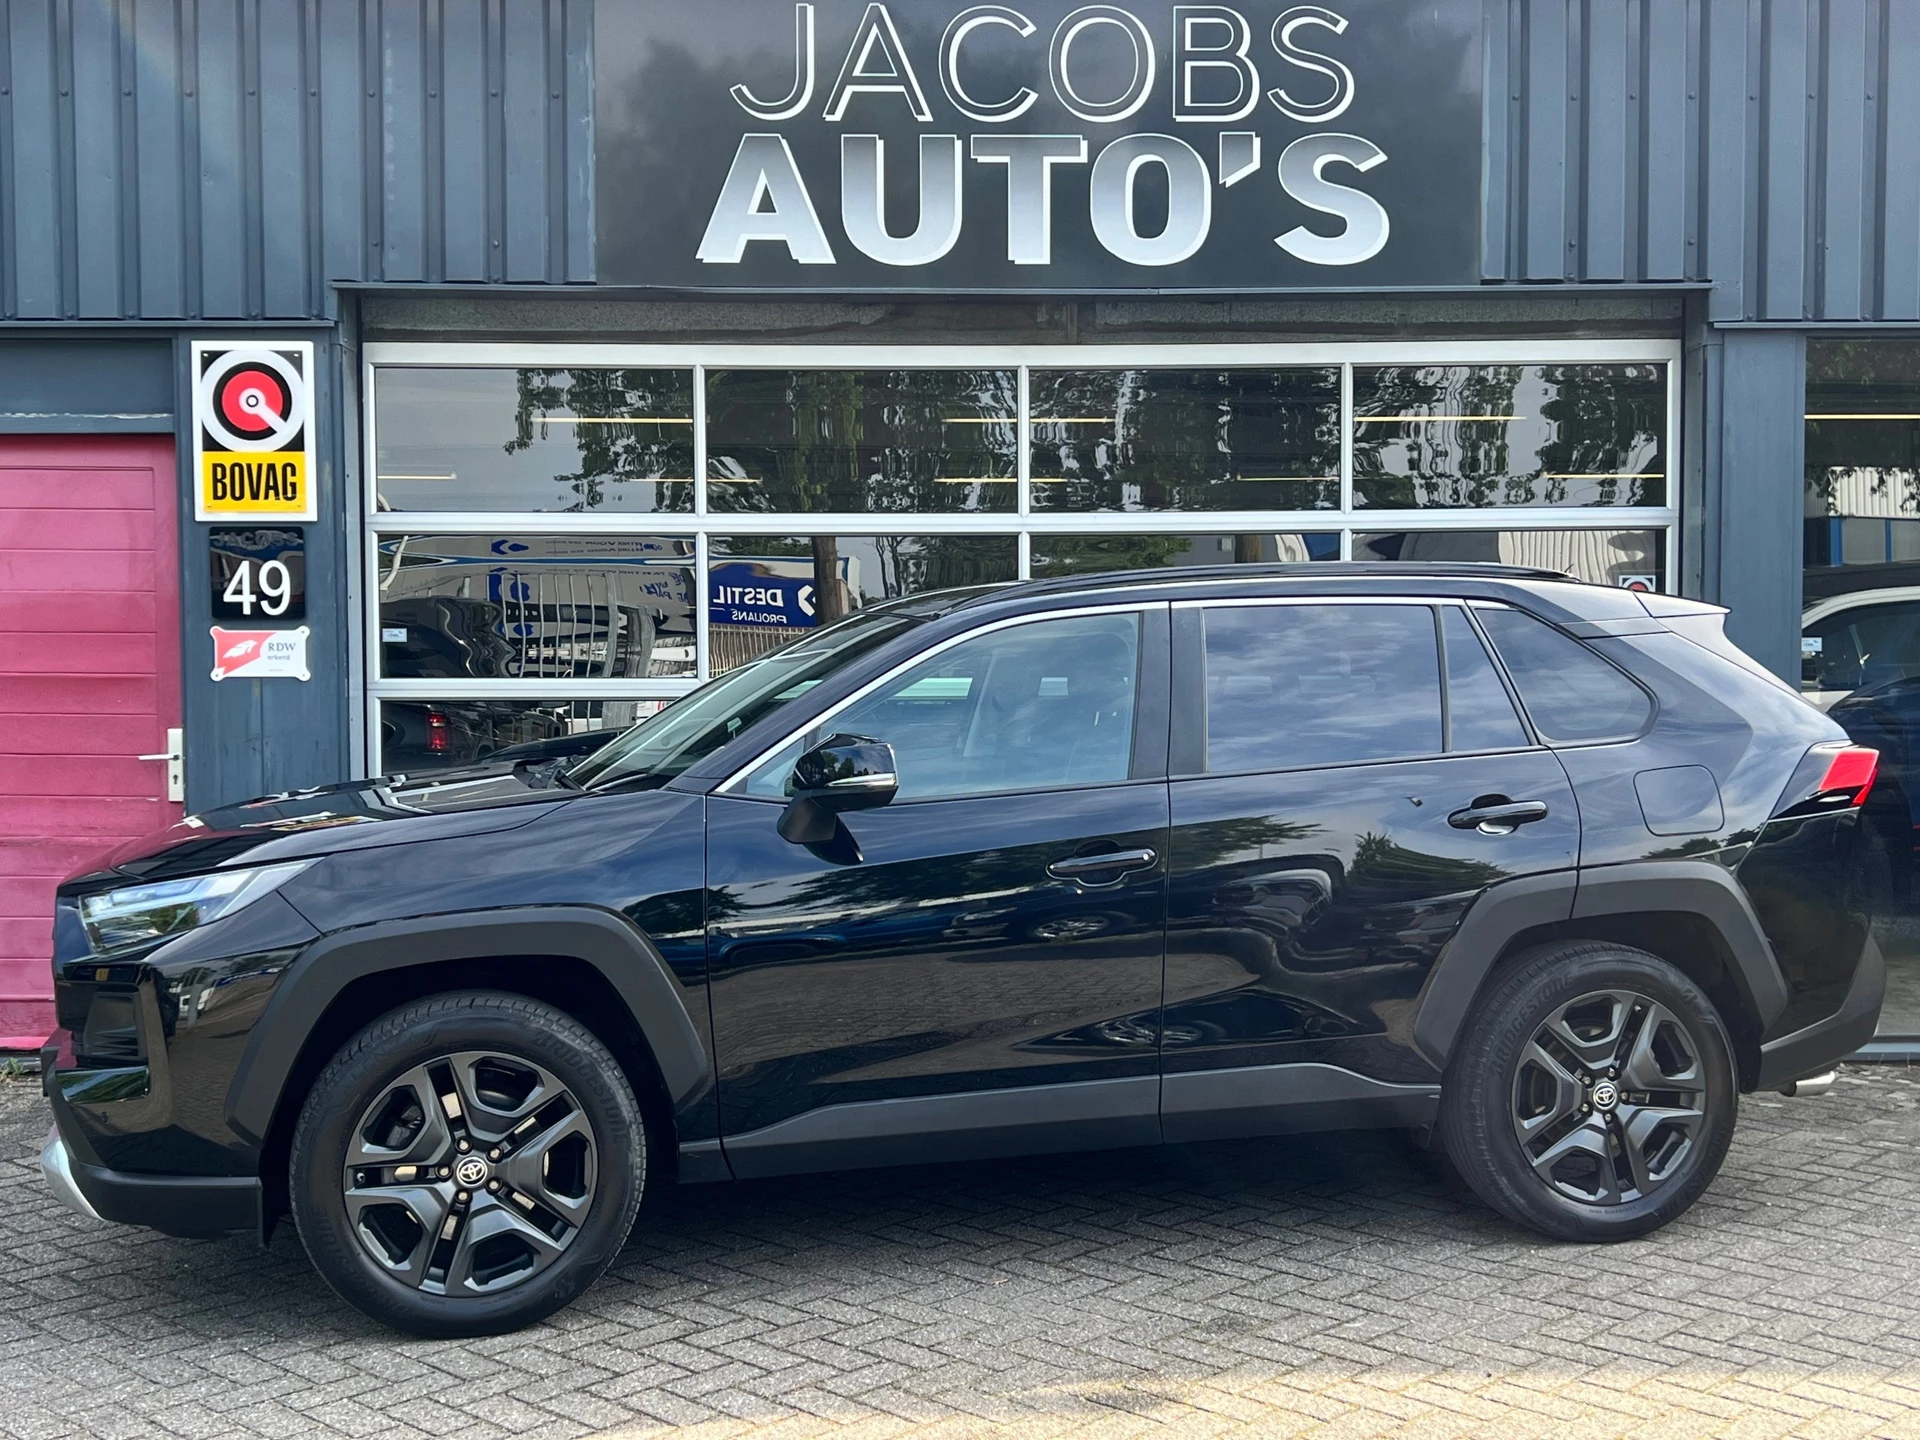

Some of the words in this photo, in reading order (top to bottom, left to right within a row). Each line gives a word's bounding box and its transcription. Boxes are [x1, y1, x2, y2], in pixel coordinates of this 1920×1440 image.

[729, 3, 1356, 123] JACOBS
[695, 132, 1390, 265] AUTO'S
[212, 462, 297, 501] BOVAG
[213, 531, 299, 547] JACOBS
[223, 560, 291, 616] 49
[267, 642, 297, 652] RDW
[1487, 971, 1573, 1080] BRIDGESTONE
[530, 1030, 627, 1143] BRIDGESTONE
